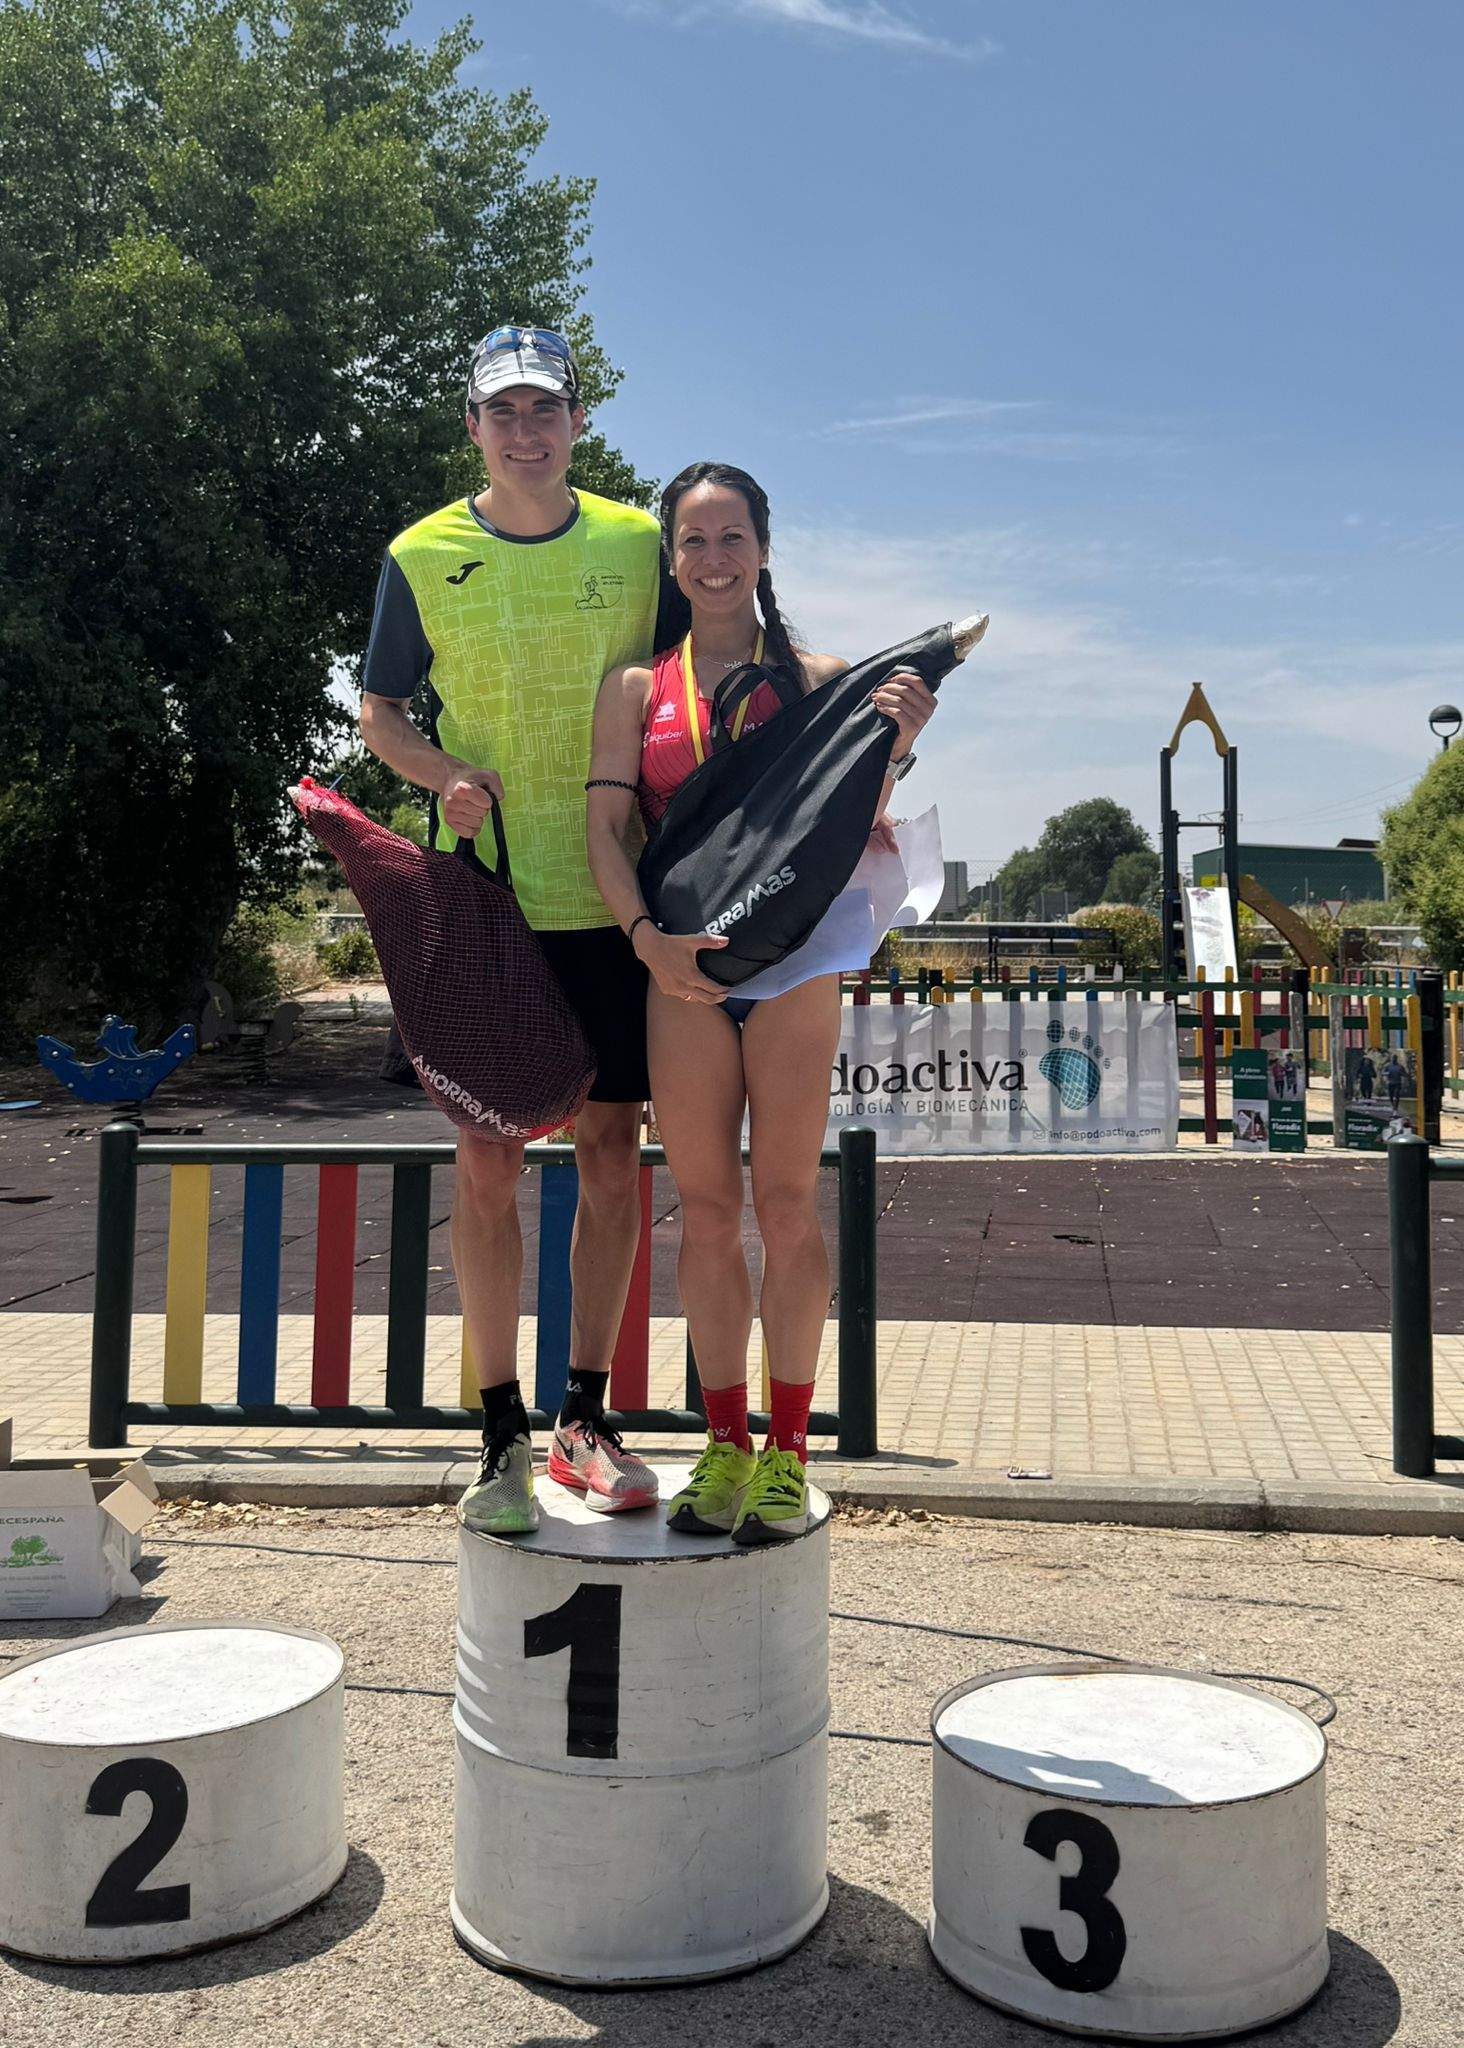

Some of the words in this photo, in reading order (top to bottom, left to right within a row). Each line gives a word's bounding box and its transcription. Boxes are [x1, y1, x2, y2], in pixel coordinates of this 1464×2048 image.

[902, 1101, 910, 1113] Y
[917, 1095, 1029, 1113] BIOMECÁNICA
[523, 1583, 623, 1760] 1
[85, 1757, 191, 1928] 2
[1019, 1809, 1129, 1992] 3
